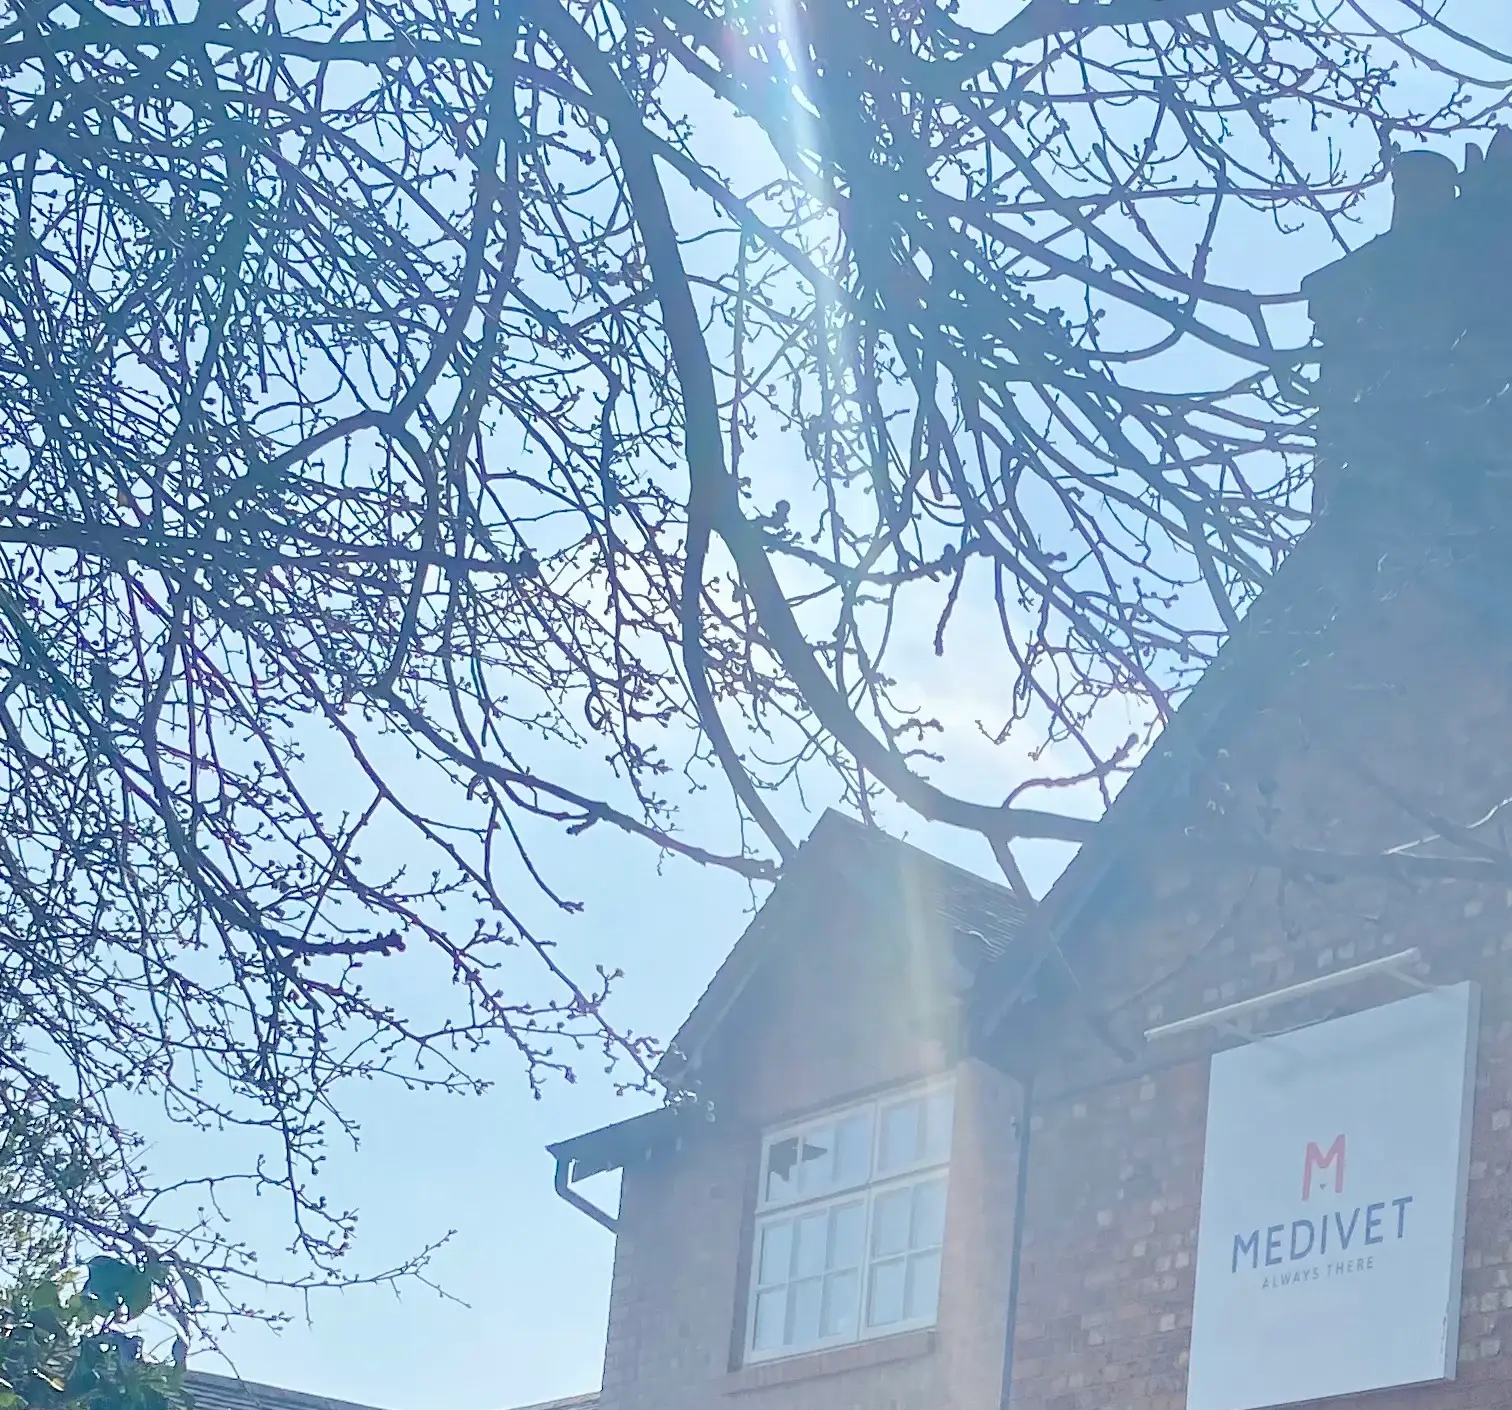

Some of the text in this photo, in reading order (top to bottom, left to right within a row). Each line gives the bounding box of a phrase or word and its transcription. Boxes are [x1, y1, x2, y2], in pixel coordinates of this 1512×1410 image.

[1301, 1133, 1346, 1202] M
[1231, 1195, 1413, 1274] MEDIVET
[1261, 1255, 1375, 1290] ALWAYS THERE
